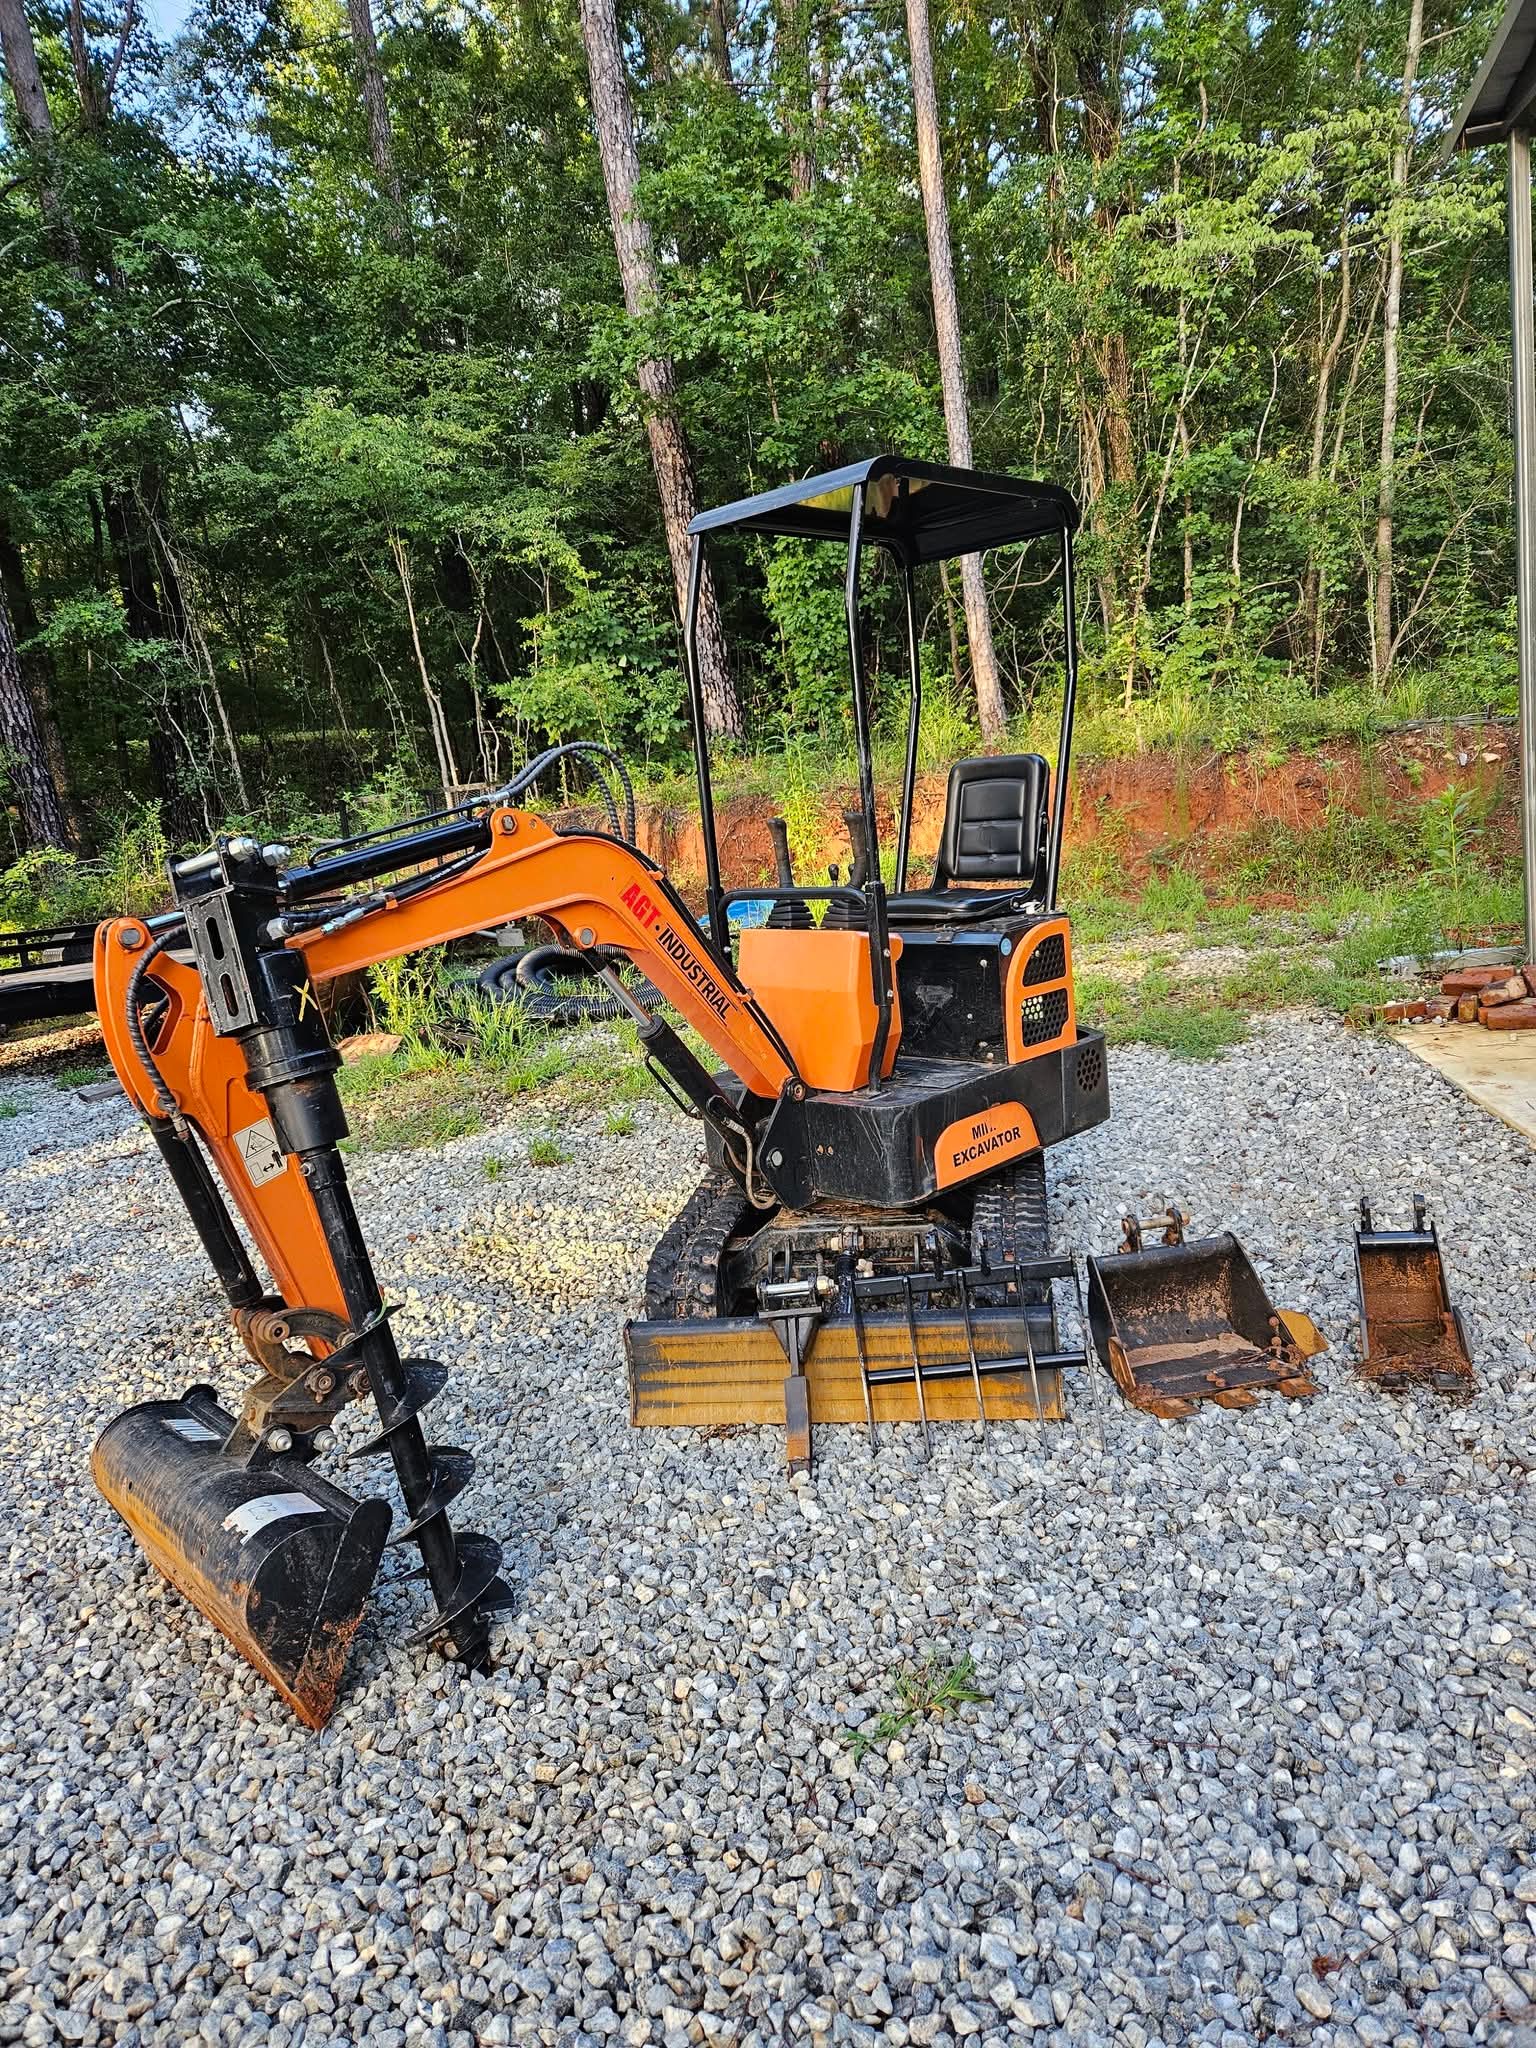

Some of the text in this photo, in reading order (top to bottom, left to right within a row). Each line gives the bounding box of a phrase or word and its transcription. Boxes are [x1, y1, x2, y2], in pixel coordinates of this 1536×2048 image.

[620, 882, 731, 1020] AGT INDUSTRIAL
[952, 1126, 1021, 1168] EXCAVATOR
